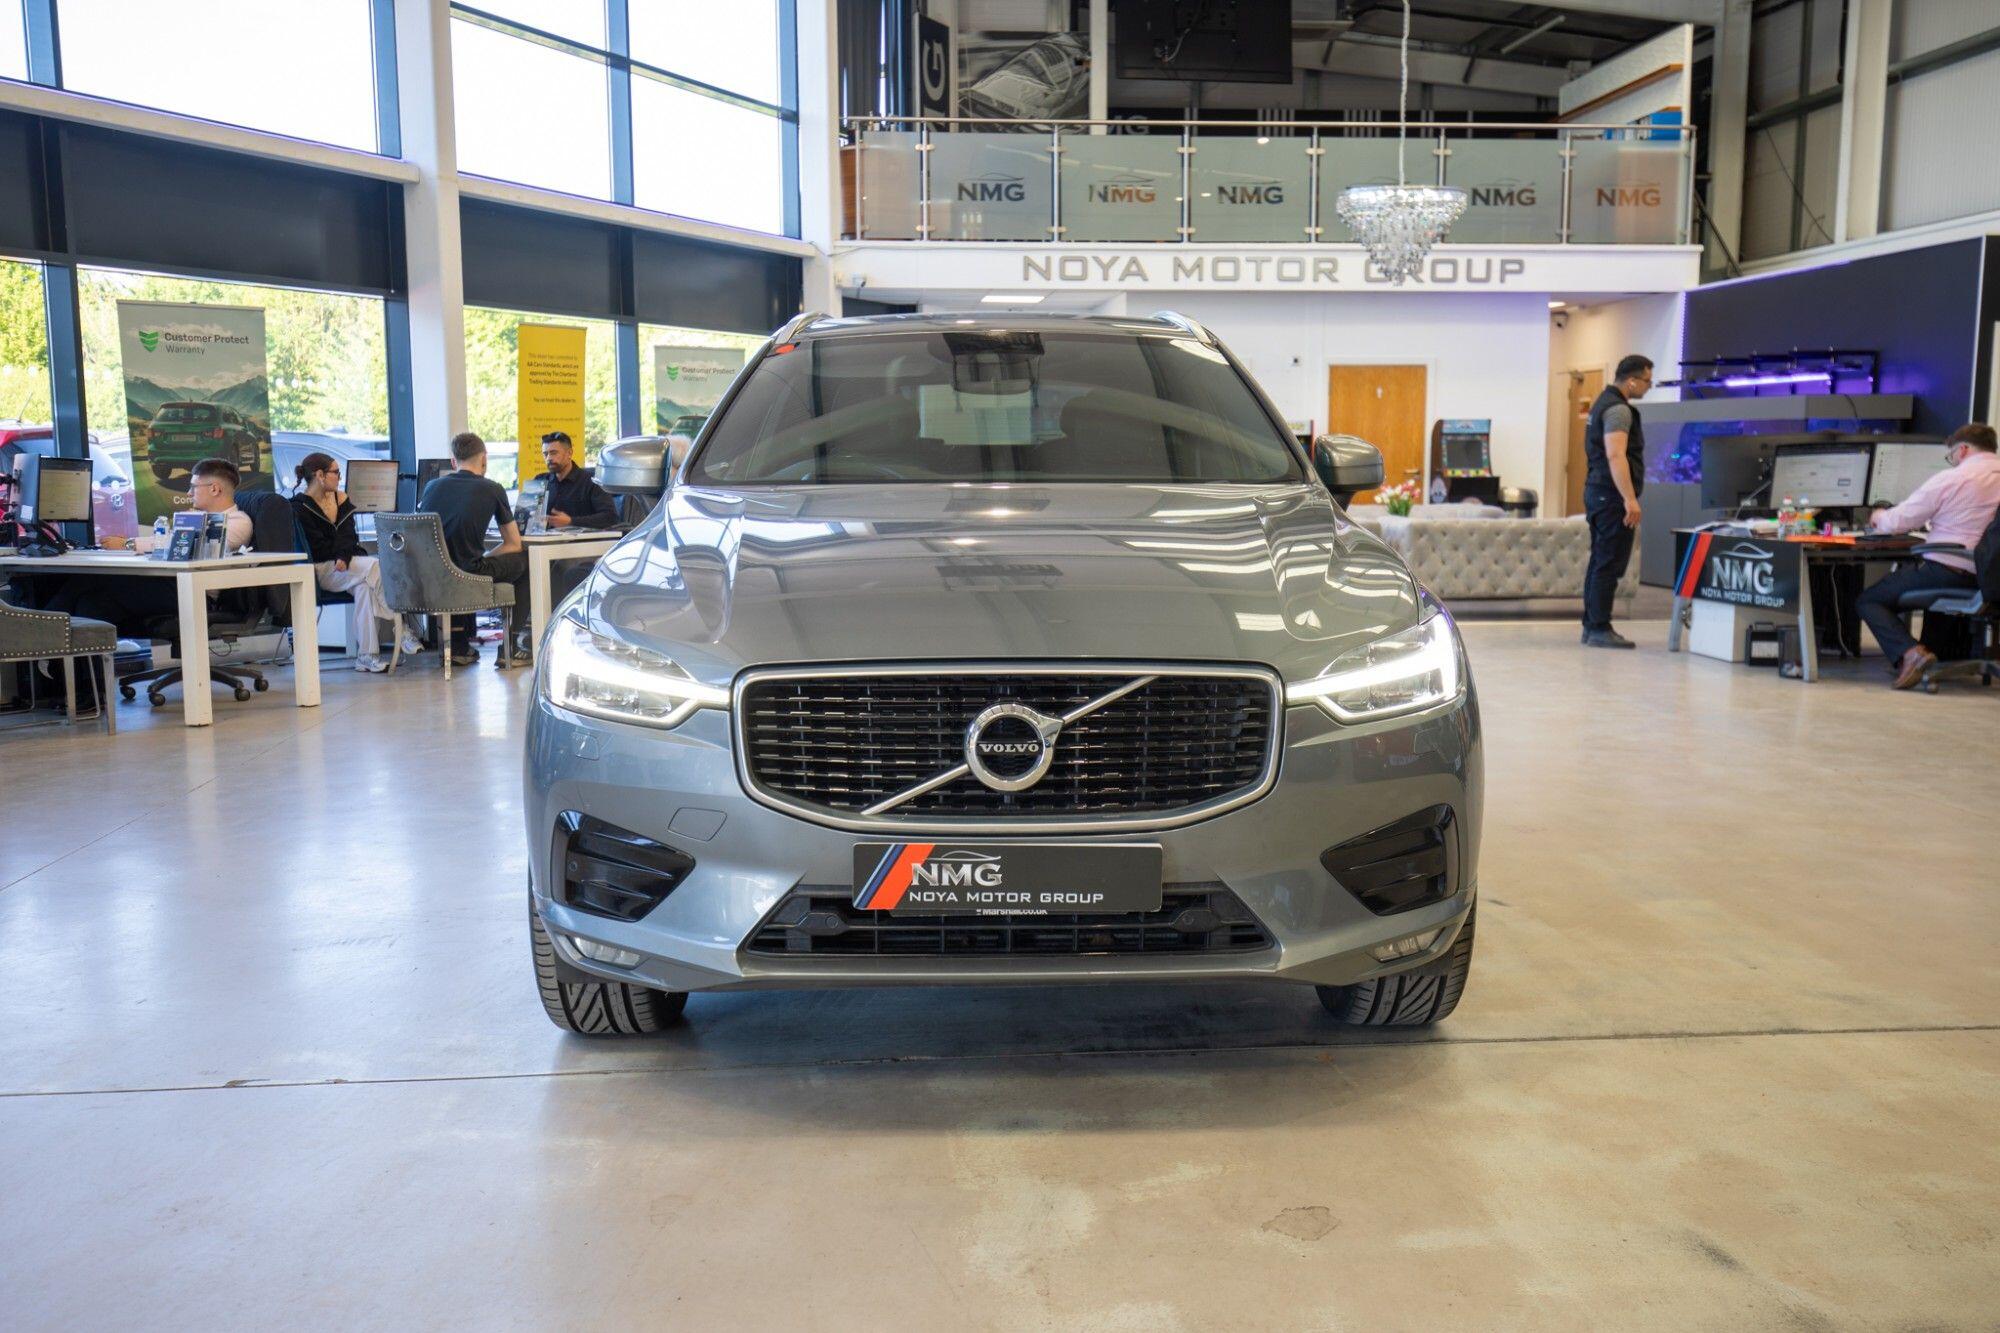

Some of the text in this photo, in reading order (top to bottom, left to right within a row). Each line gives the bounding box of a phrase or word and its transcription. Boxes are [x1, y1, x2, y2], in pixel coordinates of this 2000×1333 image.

[957, 182, 1025, 202] NMG
[1088, 184, 1156, 203] NMG
[1218, 186, 1284, 204] NMG
[1471, 188, 1537, 206] NMG
[1596, 187, 1662, 206] NMG
[1023, 255, 1149, 282] NOYA
[1173, 256, 1339, 283] MOTOR
[164, 332, 250, 345] Customer Protect
[165, 344, 206, 355] Warranty
[1712, 557, 1774, 594] NMG
[1701, 587, 1785, 608] NOYA MOTOR GROUP
[979, 743, 1039, 753] VOLVO
[911, 863, 1002, 887] NMG
[909, 891, 1104, 904] NOYA MOTOR GROUP
